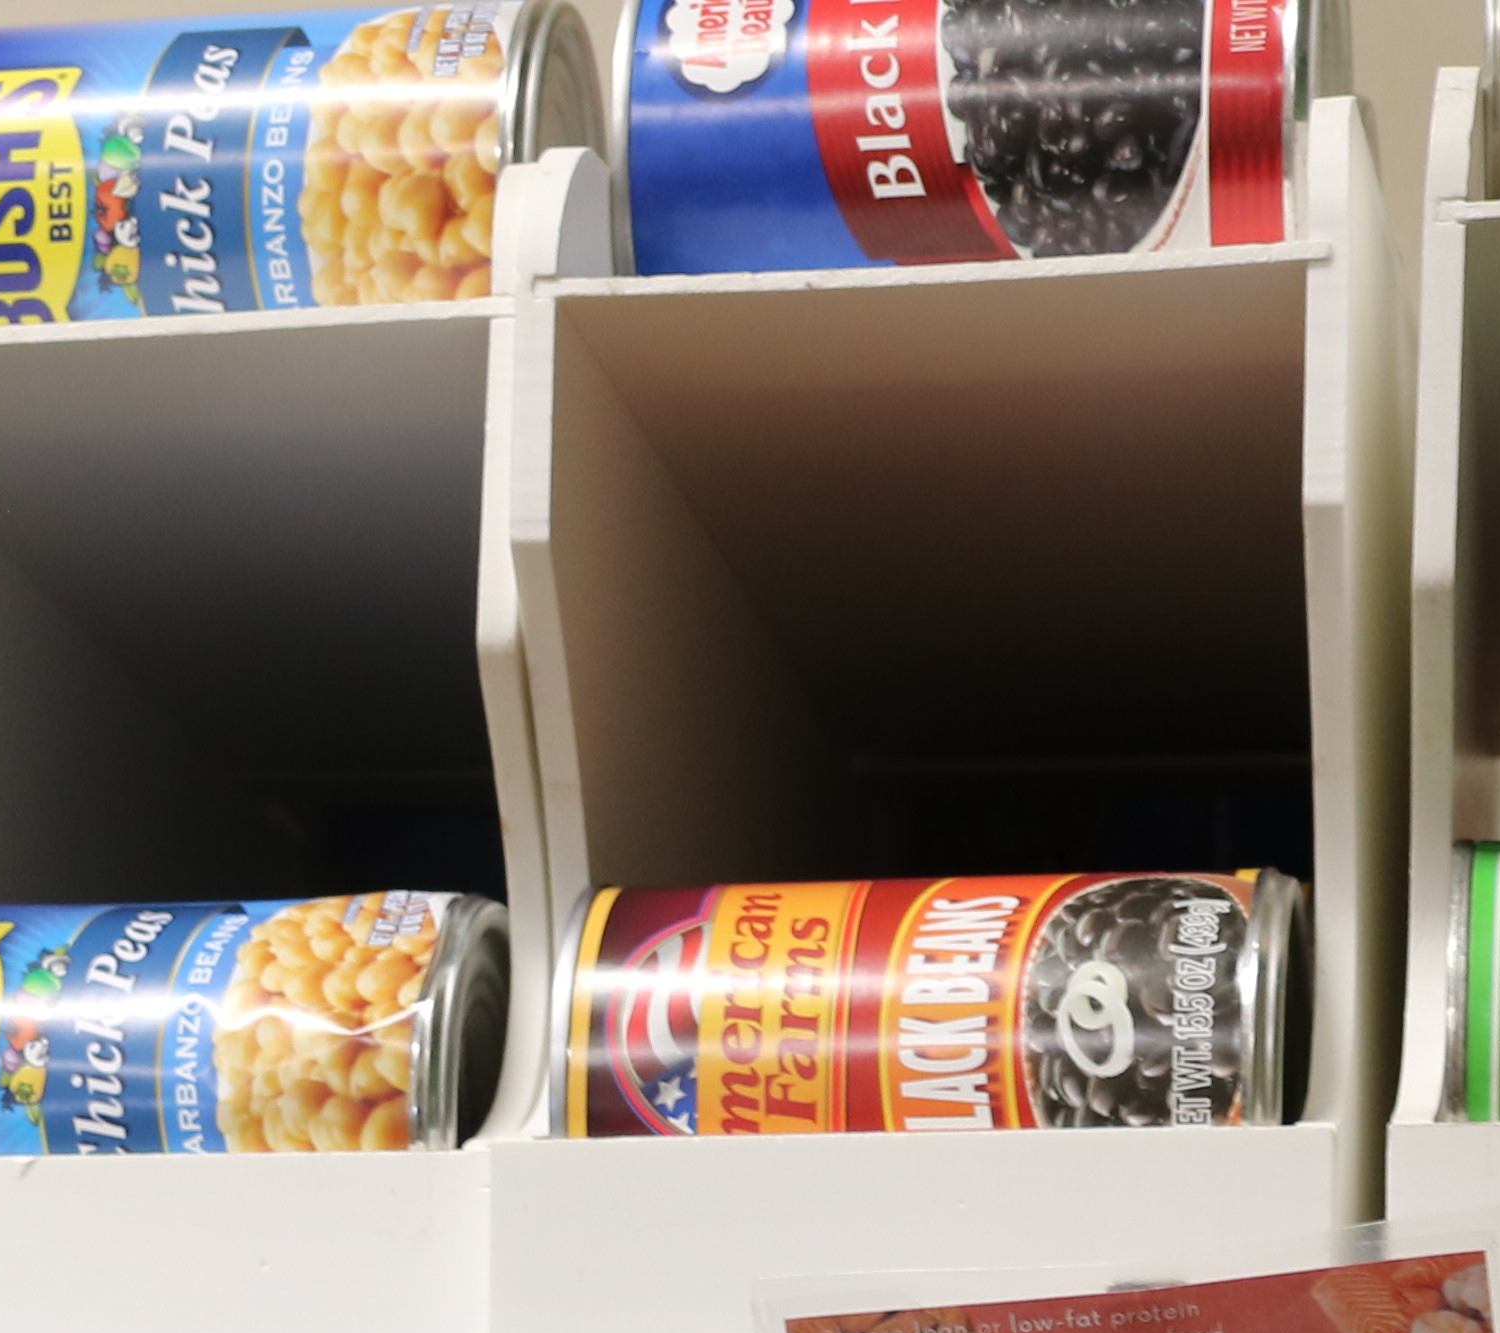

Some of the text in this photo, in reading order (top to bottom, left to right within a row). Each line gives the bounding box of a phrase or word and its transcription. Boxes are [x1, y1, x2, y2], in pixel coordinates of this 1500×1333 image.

[164, 43, 240, 162] Peas
[855, 14, 928, 200] Black
[50, 164, 73, 243] BEST
[87, 908, 175, 999] Peas
[903, 896, 1021, 1006] BEANS
[765, 915, 830, 1125] Farms
[1009, 1310, 1101, 1333] low-fat
[1110, 1302, 1200, 1331] protein
